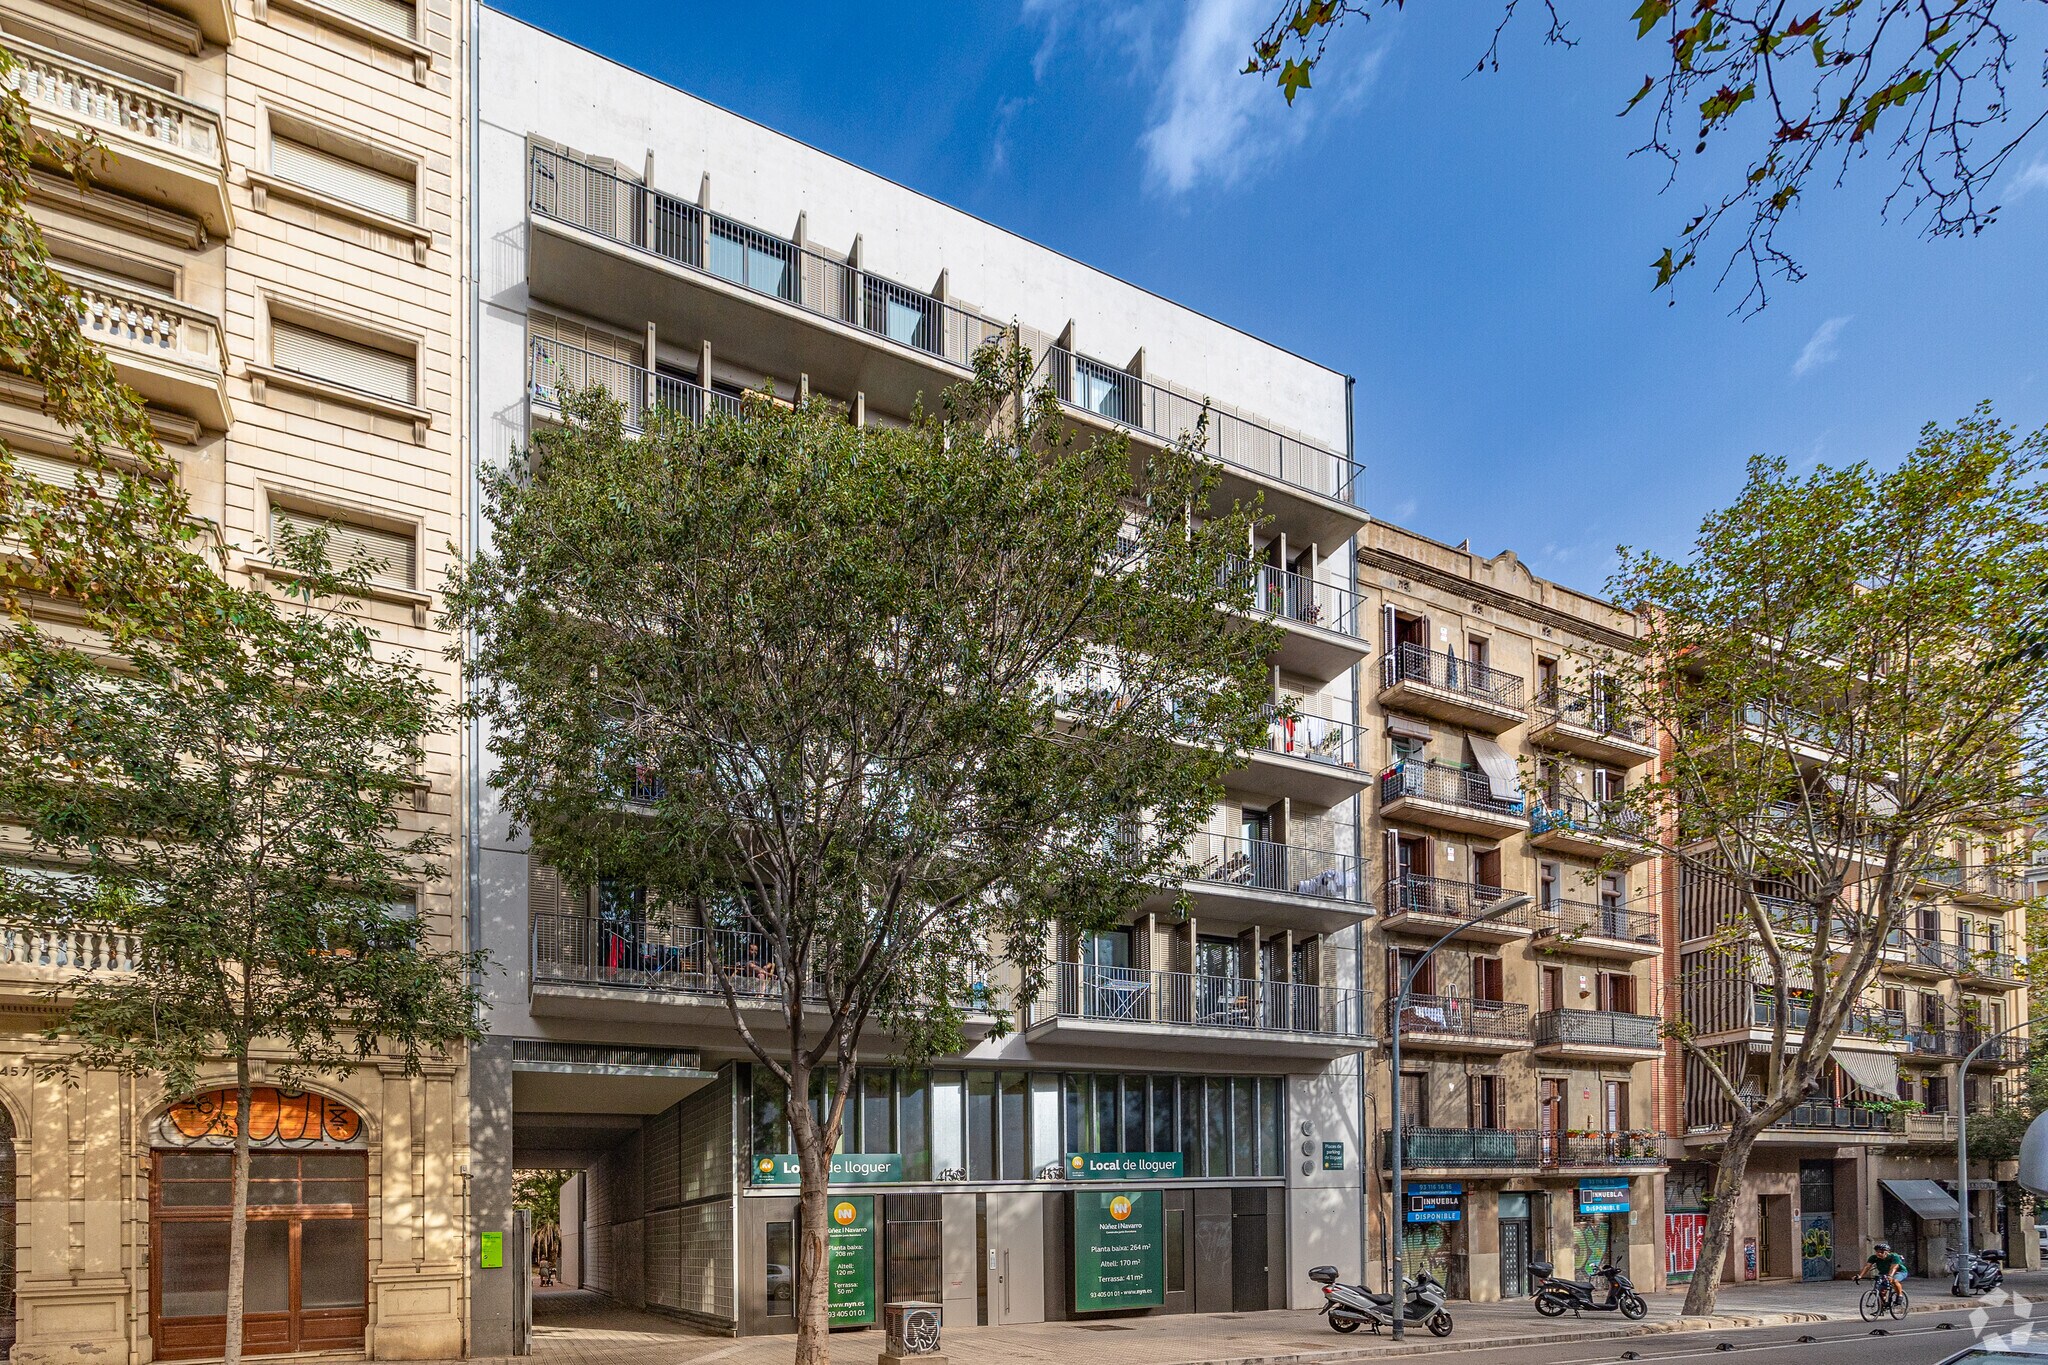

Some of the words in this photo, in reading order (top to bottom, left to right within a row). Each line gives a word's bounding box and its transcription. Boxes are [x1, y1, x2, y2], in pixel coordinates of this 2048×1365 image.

[0, 1066, 30, 1077] 457
[845, 1161, 891, 1175] lloguer
[1090, 1160, 1120, 1170] Local
[1122, 1160, 1136, 1170] de
[1139, 1159, 1176, 1172] lloguer
